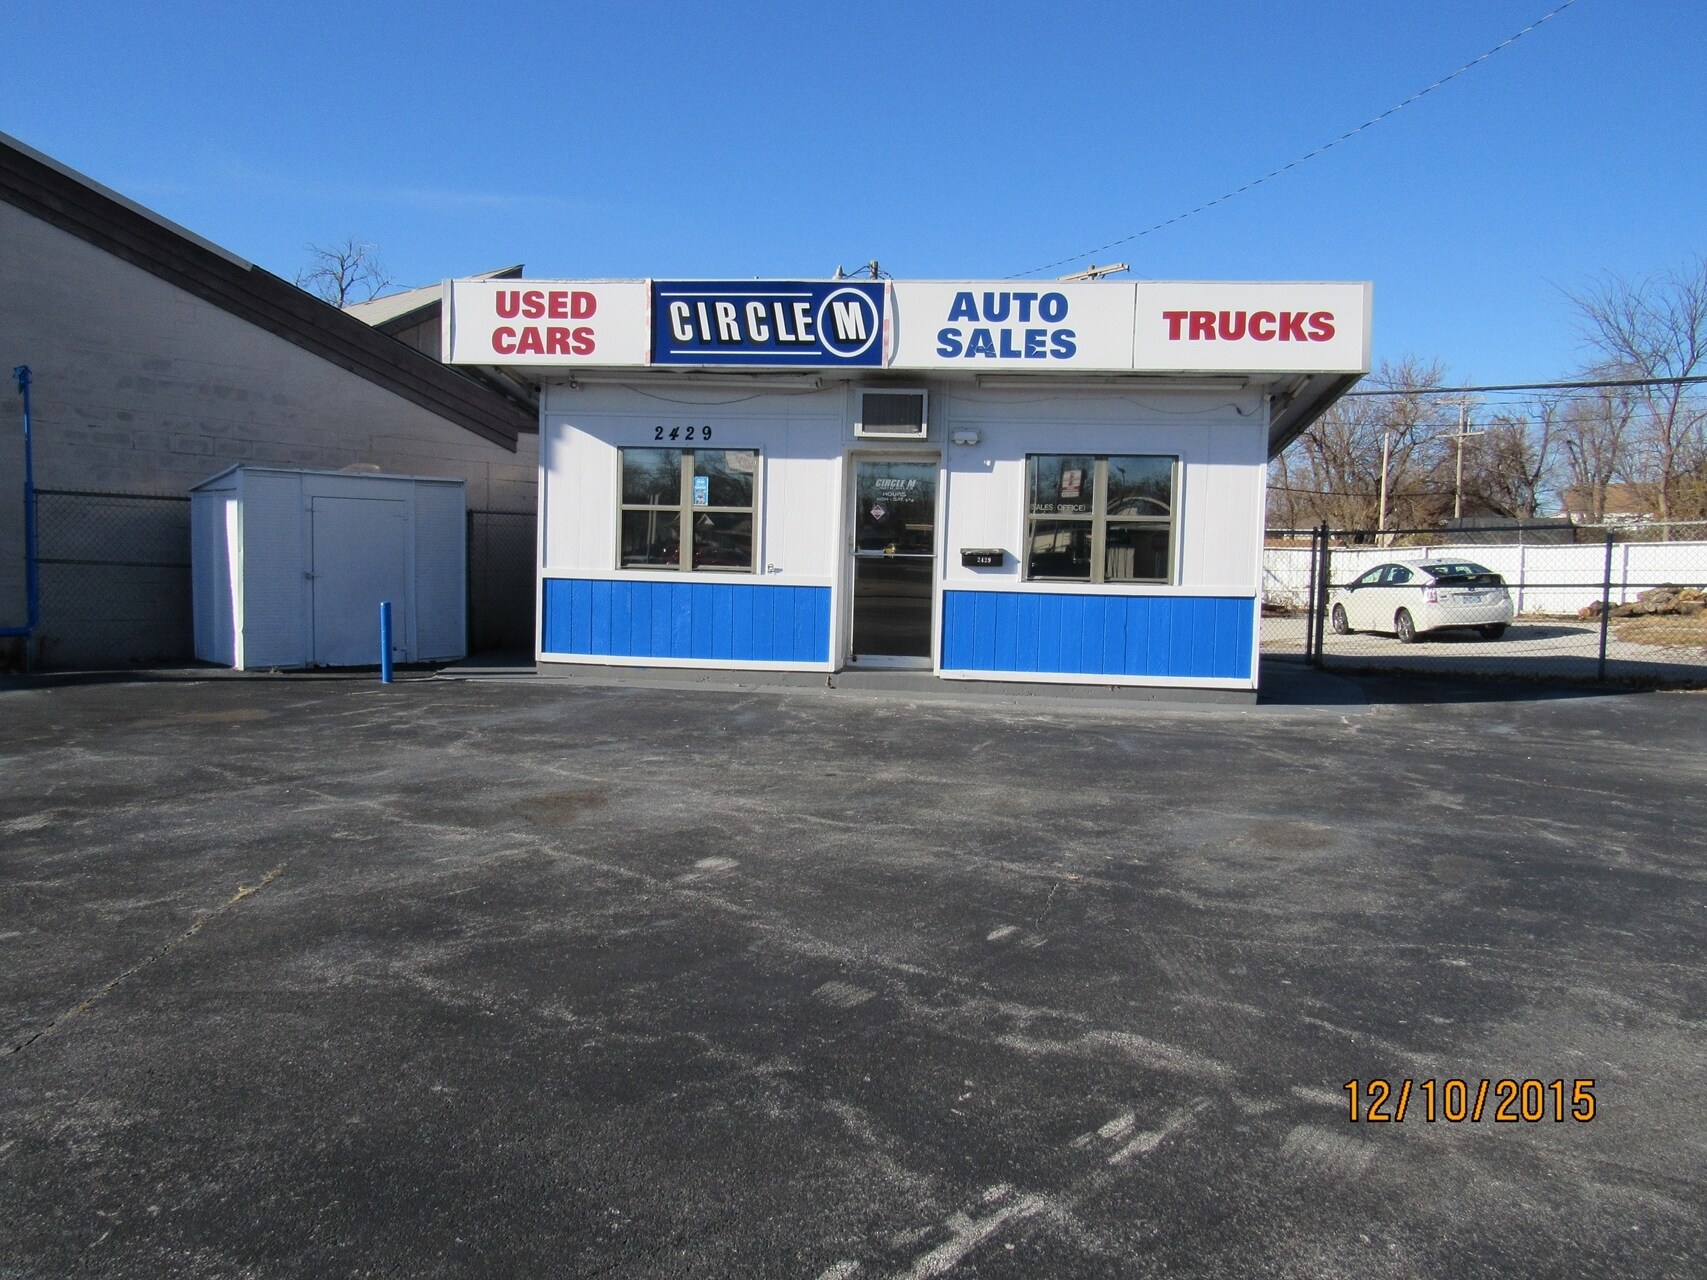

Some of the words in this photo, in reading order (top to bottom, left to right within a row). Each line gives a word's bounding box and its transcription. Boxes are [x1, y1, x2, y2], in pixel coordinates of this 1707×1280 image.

[496, 290, 597, 320] USED
[947, 291, 1069, 323] AUTO
[669, 301, 816, 343] CIRCLE
[832, 301, 867, 341] M
[1163, 310, 1336, 342] TRUCKS
[492, 326, 596, 356] CARS
[936, 327, 1077, 360] SALES
[654, 425, 712, 441] 2429
[875, 479, 907, 488] CIRCLE
